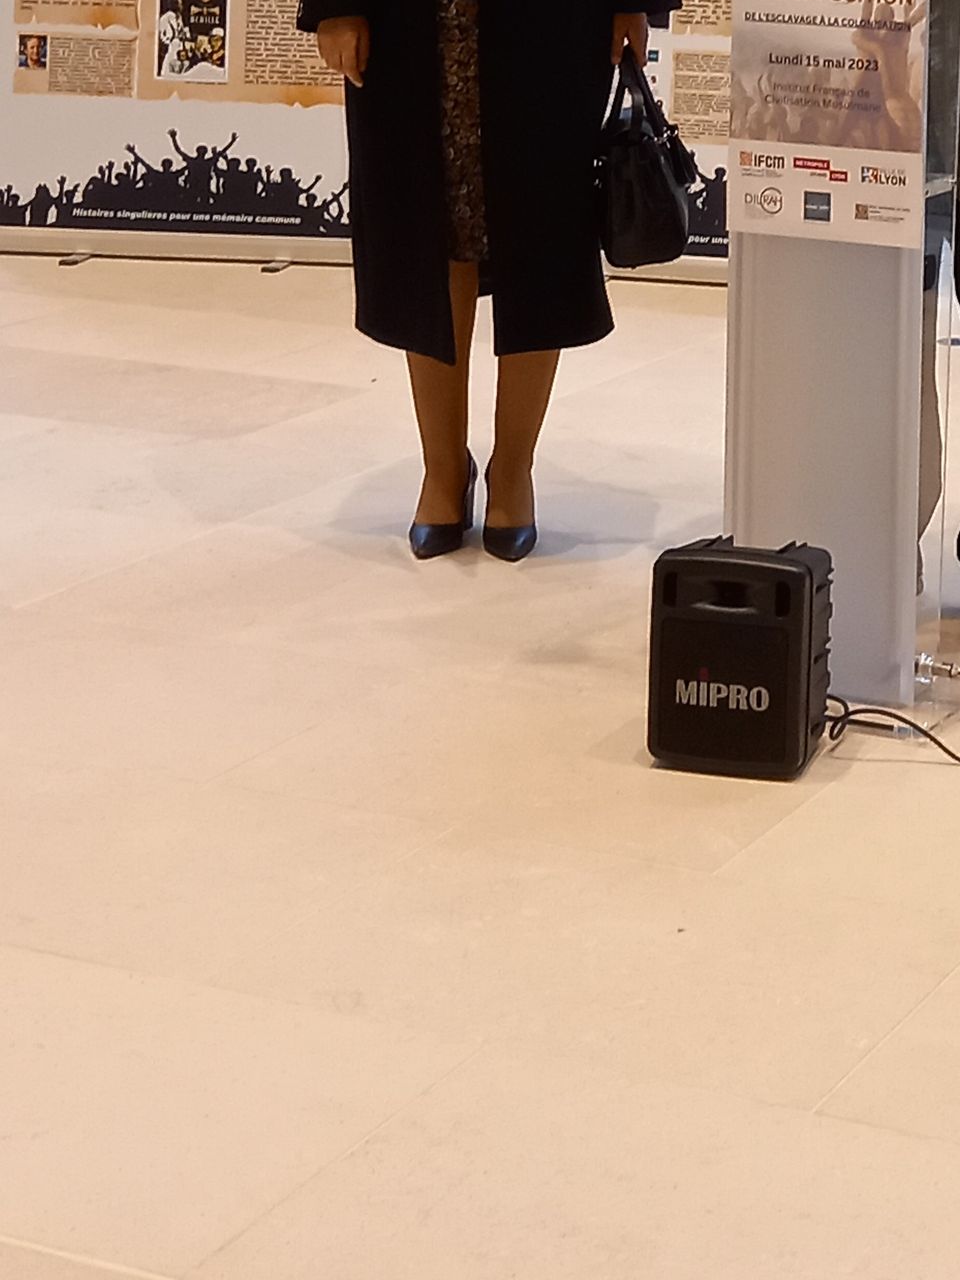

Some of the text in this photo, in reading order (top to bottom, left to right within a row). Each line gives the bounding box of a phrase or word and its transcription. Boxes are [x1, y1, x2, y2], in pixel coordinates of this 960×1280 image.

[744, 12, 757, 21] DE
[758, 12, 818, 25] L'ESCLAVAGE
[828, 18, 839, 26] LA
[769, 52, 879, 71] Lundi 15 mai 2023
[879, 175, 906, 187] LYON
[72, 208, 114, 218] Histoires
[169, 213, 190, 222] pour
[193, 213, 210, 221] une
[255, 215, 301, 225] commune
[688, 235, 710, 244] pour
[675, 679, 770, 712] MIPRO
